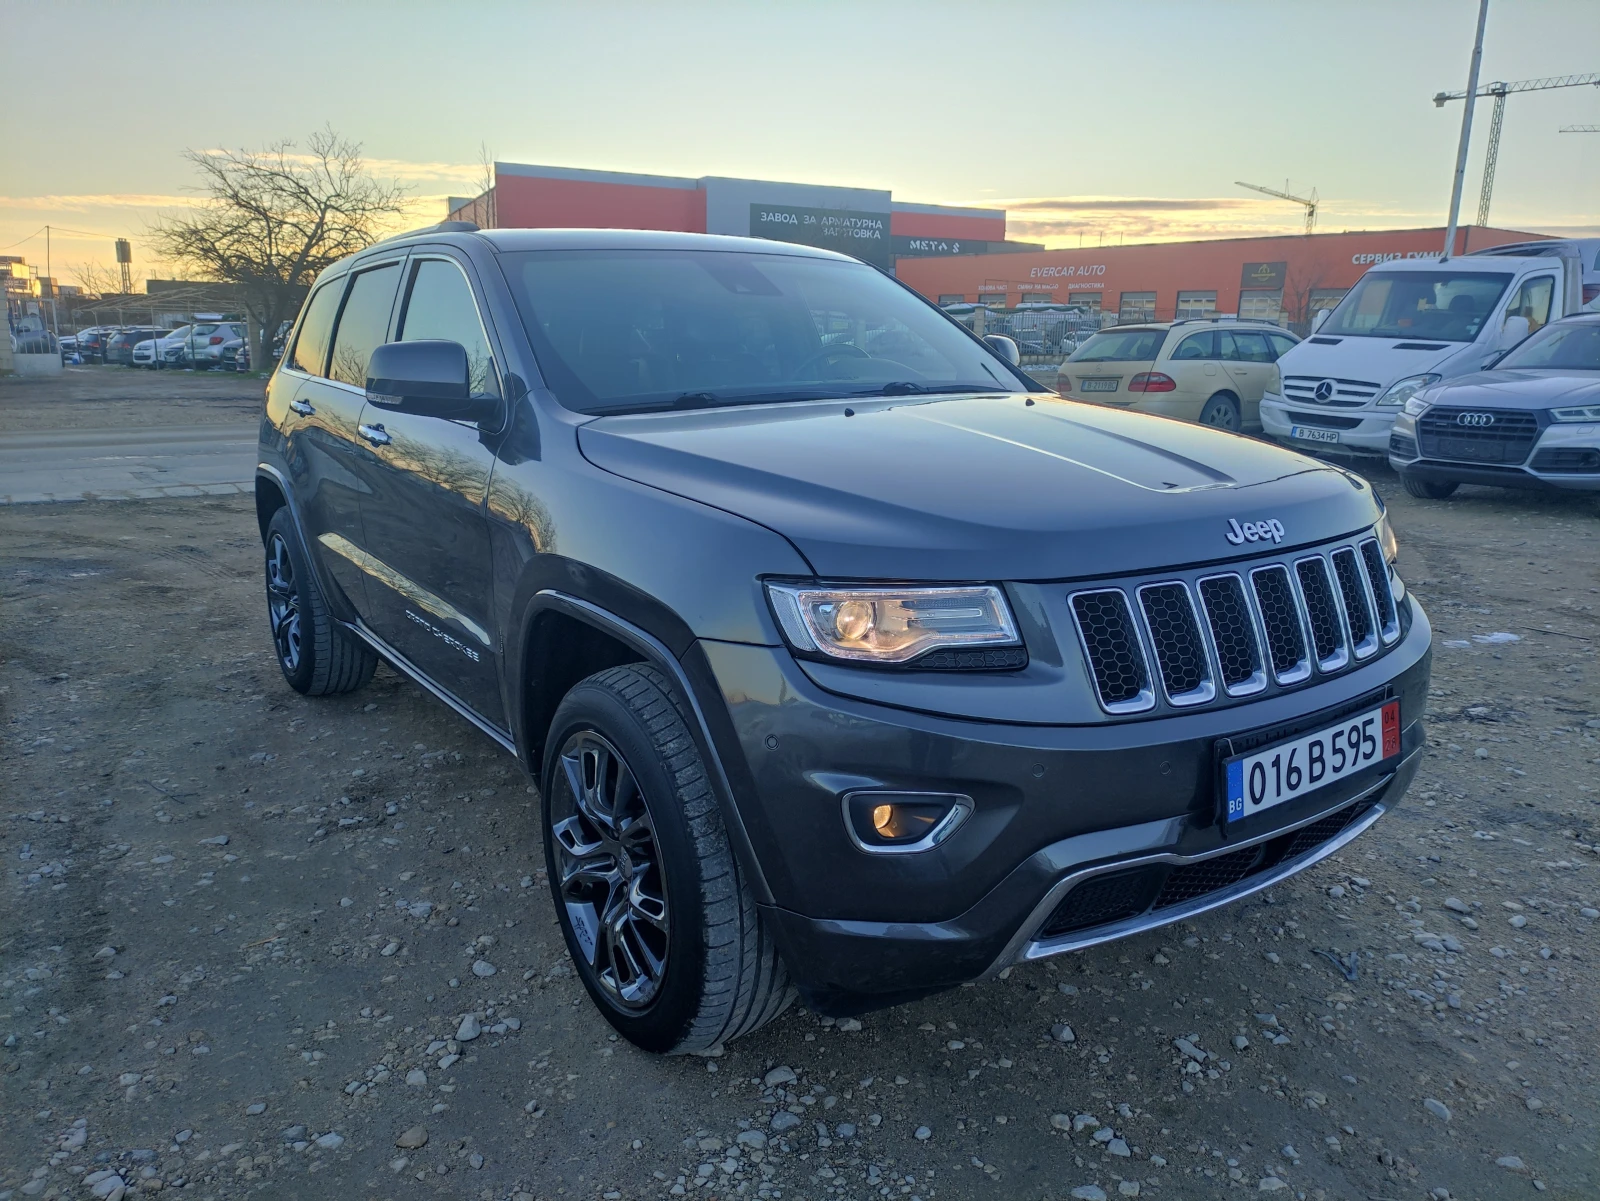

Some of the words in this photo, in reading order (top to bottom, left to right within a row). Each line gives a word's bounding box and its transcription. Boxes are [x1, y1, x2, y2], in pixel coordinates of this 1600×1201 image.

[760, 211, 798, 224] ЗАВОД
[803, 214, 817, 224] ЗА
[820, 215, 883, 229] АРМАТУРНА
[1351, 252, 1402, 265] СЕРВИЗ
[1030, 266, 1075, 277] EVERCAR
[1076, 265, 1106, 276] AUTO
[1225, 518, 1285, 545] Jeep
[1384, 709, 1395, 724] 04
[1385, 736, 1397, 751] 28
[1249, 717, 1378, 805] 016B595
[1229, 797, 1243, 815] BG
